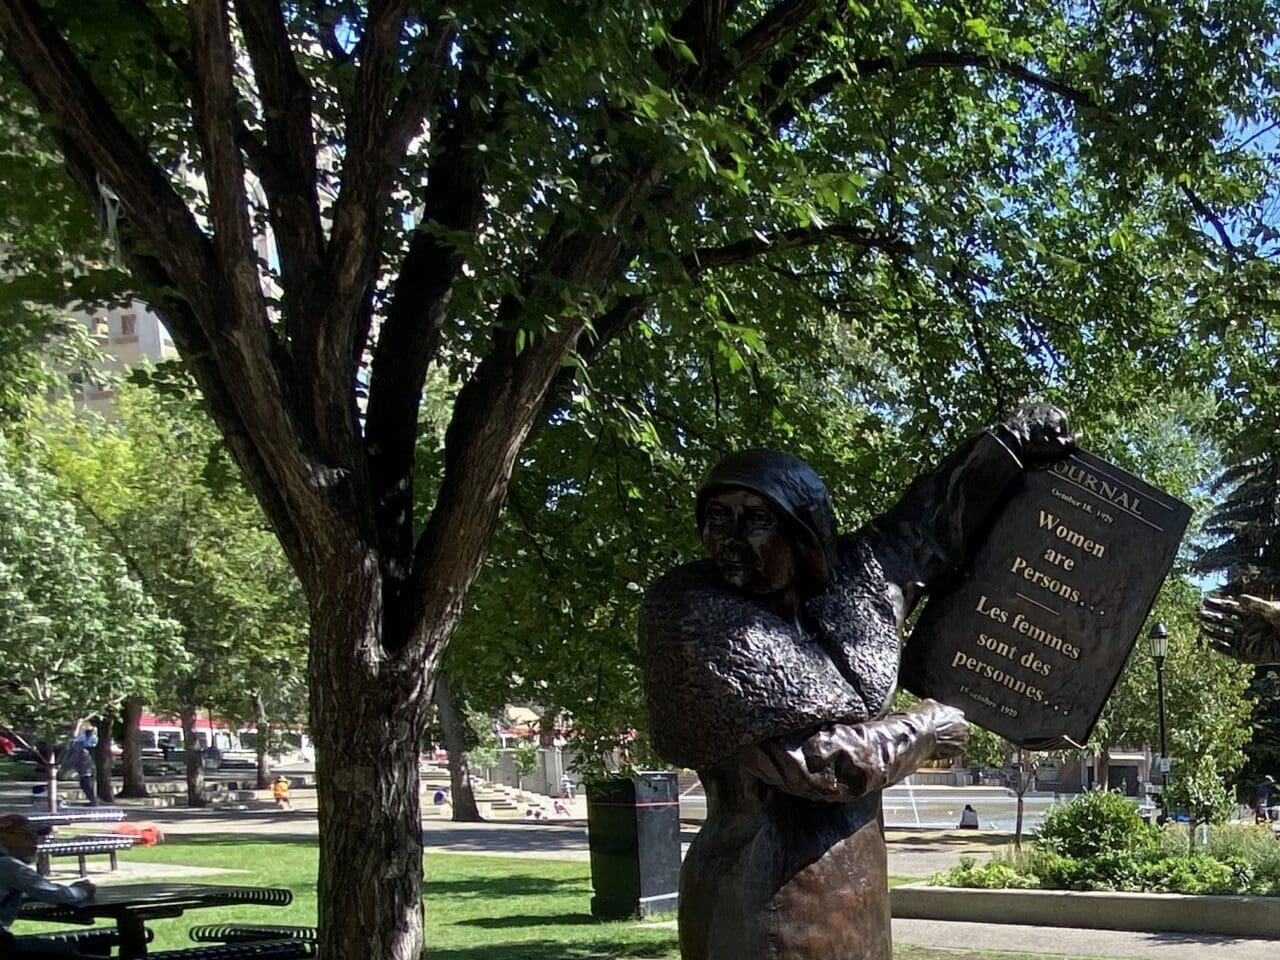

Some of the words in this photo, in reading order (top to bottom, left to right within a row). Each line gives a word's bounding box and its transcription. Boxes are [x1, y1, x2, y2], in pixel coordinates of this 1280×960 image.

[1039, 510, 1105, 558] Women
[1044, 548, 1074, 571] are
[975, 595, 1009, 623] Les
[1011, 614, 1081, 660] femmes
[976, 633, 1018, 660] sont
[1020, 652, 1052, 677] des
[1001, 704, 1018, 718] 1929
